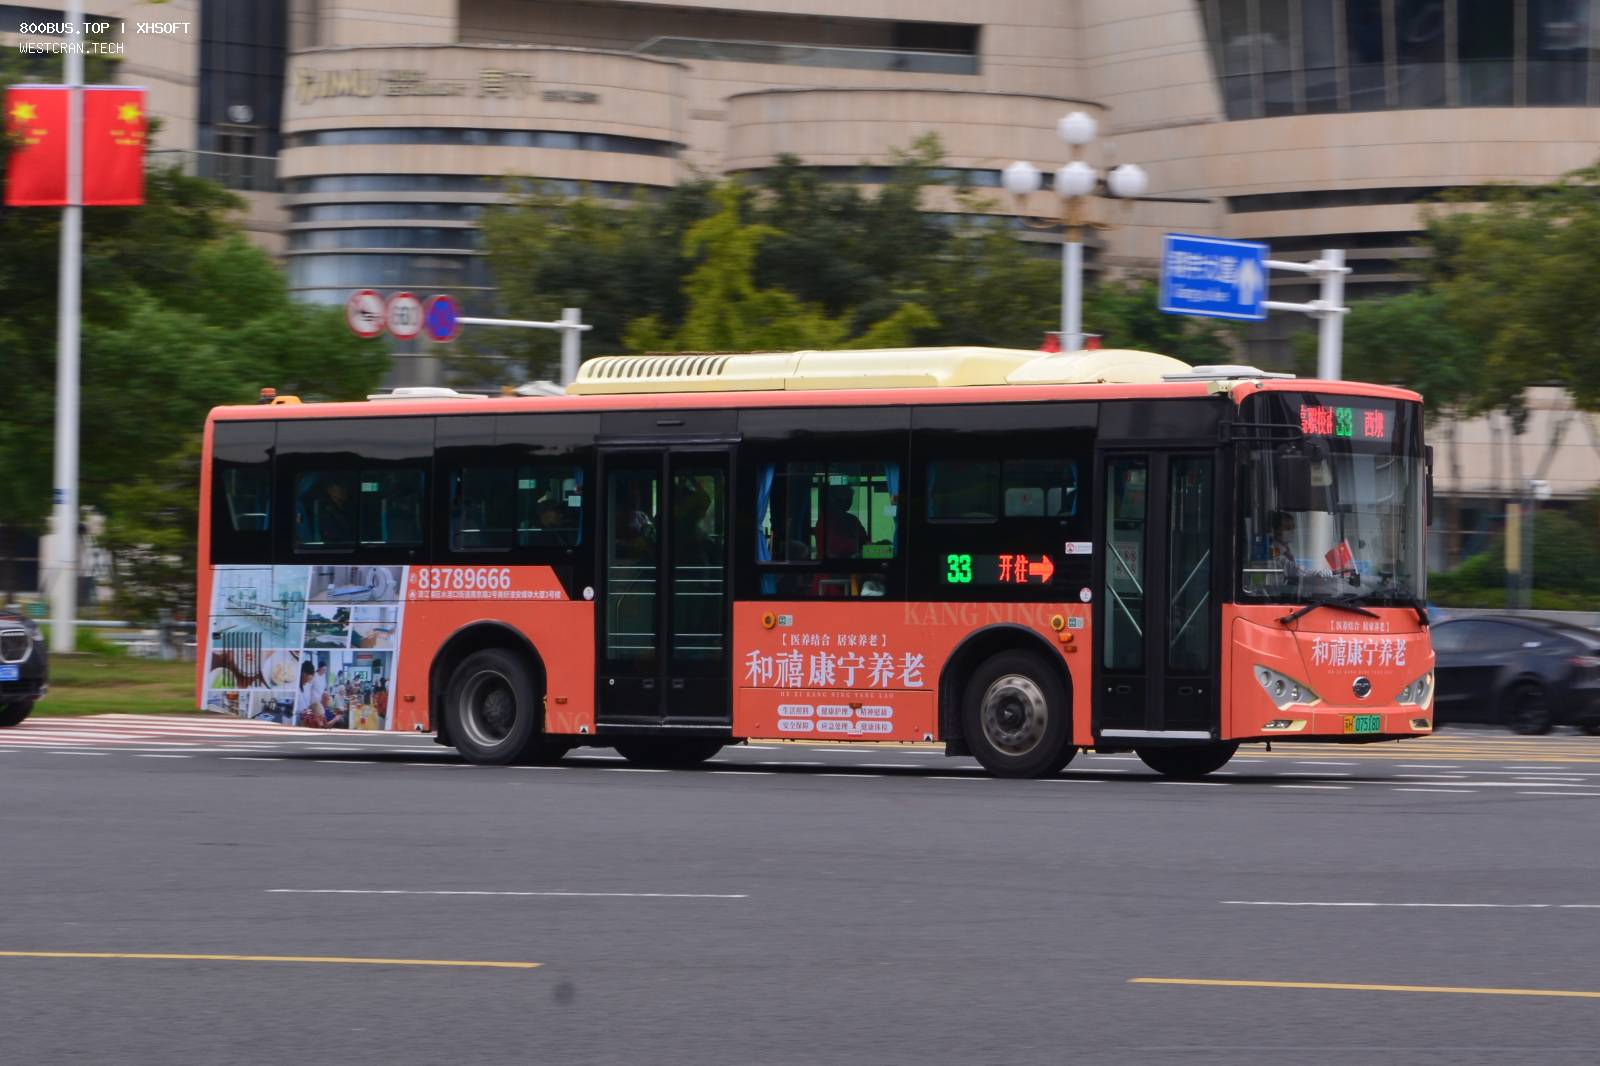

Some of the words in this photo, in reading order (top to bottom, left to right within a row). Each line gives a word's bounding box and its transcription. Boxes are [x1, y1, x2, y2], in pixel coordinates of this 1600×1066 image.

[1336, 407, 1352, 437] 33
[418, 568, 511, 589] 83789666
[946, 554, 972, 583] 33
[998, 554, 1029, 583] 开往
[1312, 637, 1406, 667] 和禧康宁养老
[745, 649, 926, 688] 和禧康宁养老
